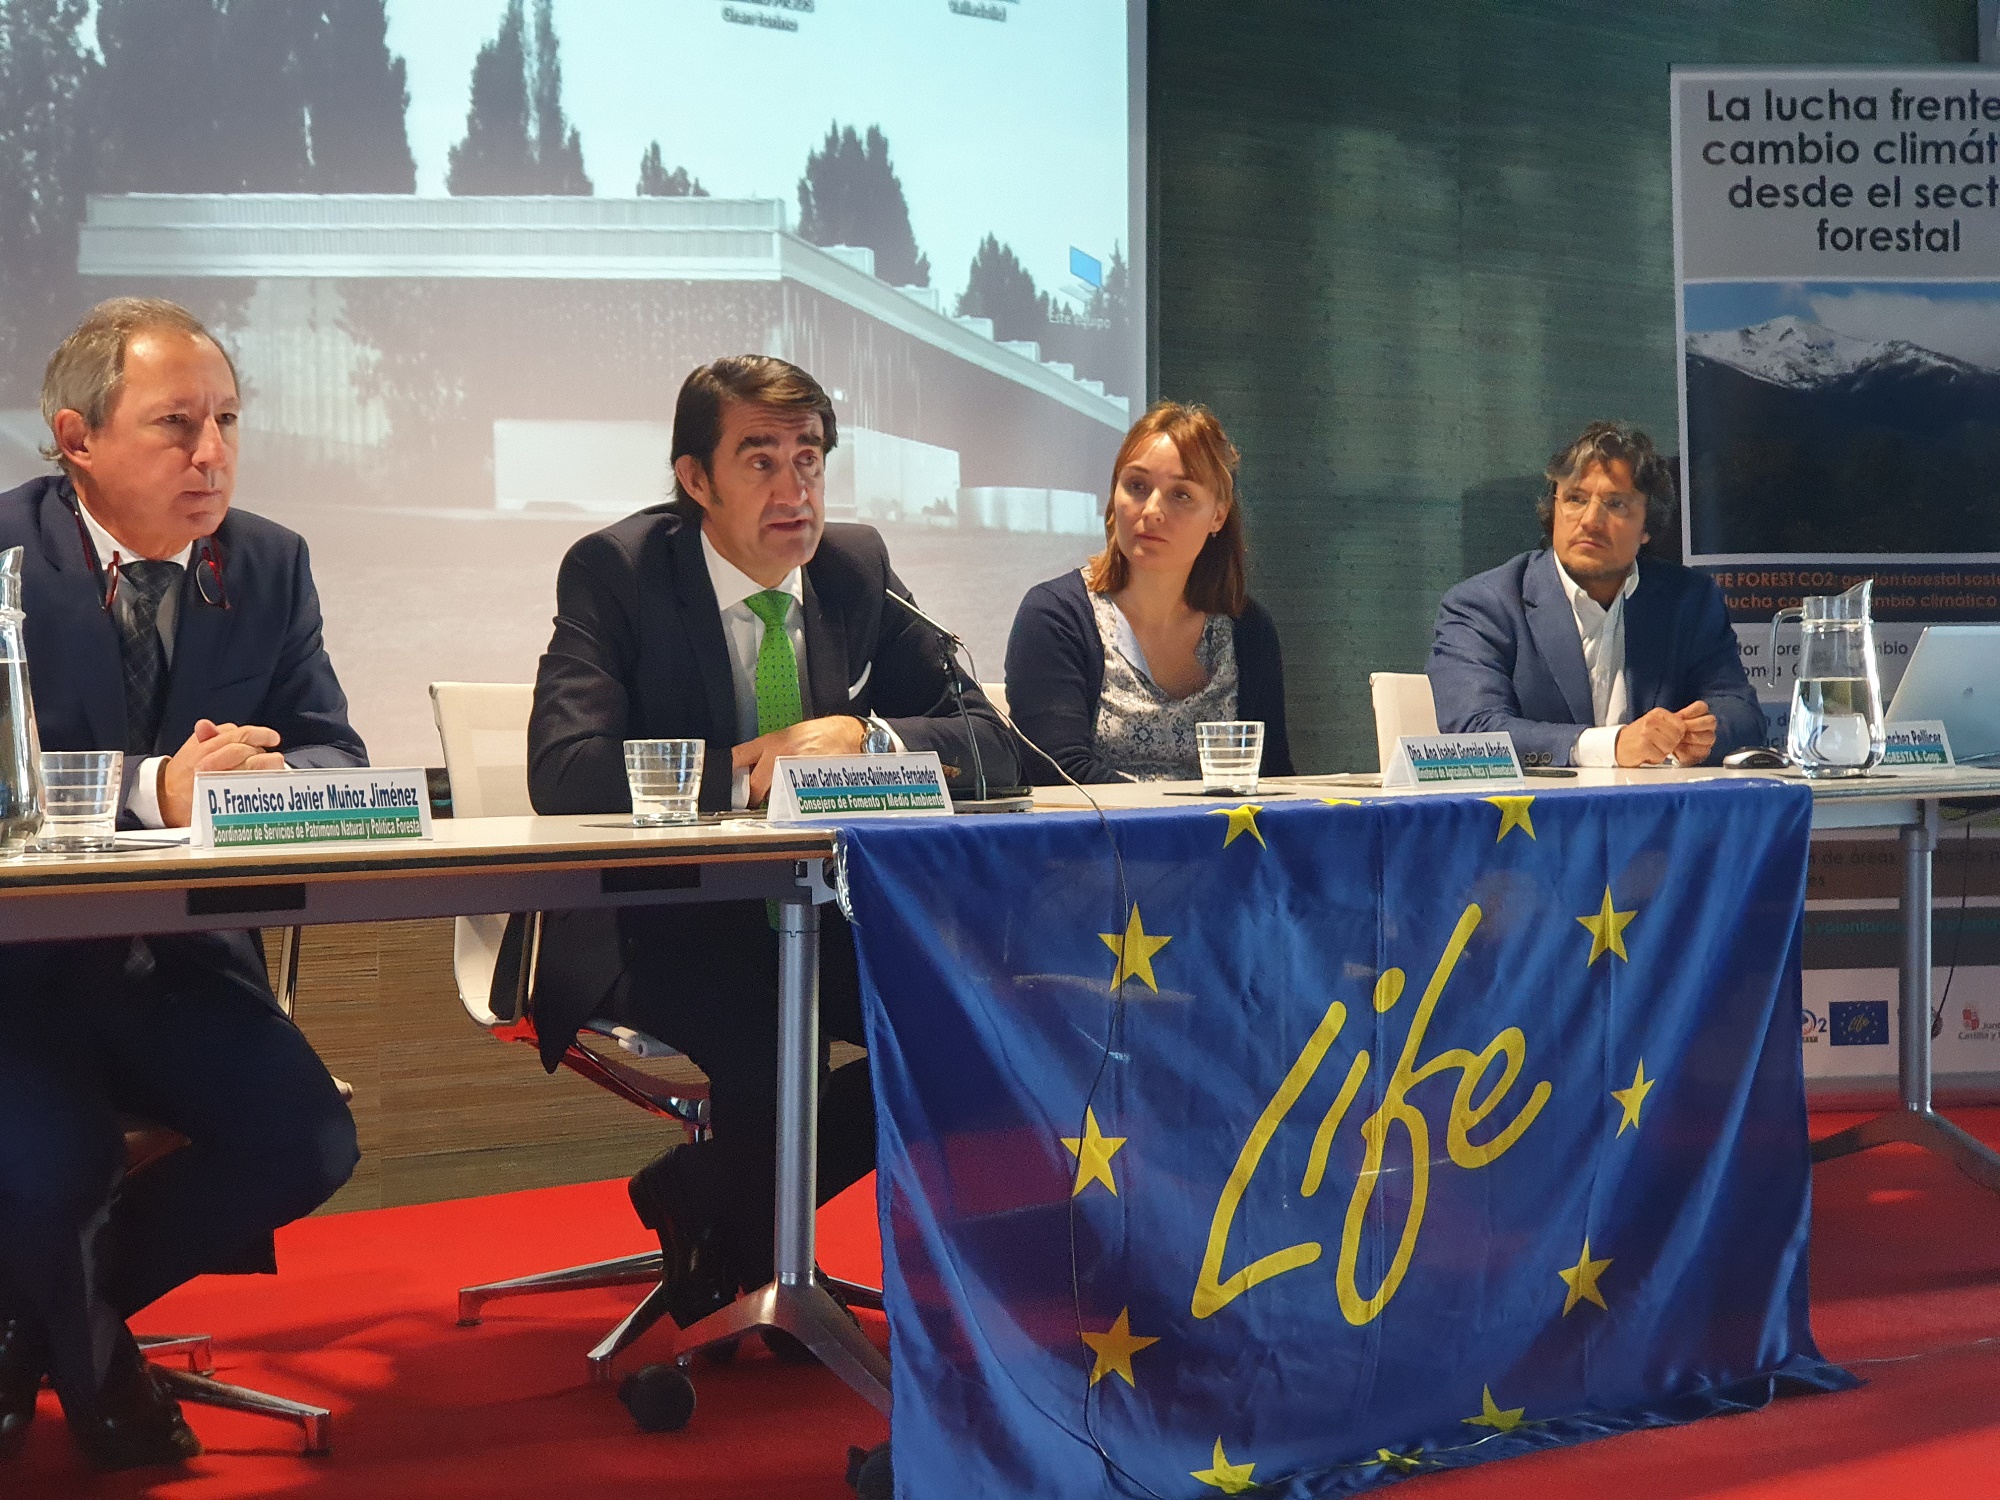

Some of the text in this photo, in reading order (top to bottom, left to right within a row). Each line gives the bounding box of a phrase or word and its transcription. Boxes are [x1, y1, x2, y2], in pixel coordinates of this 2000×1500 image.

[1707, 88, 2000, 122] La lucha frente
[1703, 127, 1999, 165] cambio climát
[1728, 174, 1999, 208] desde el sect
[1817, 218, 1961, 252] forestal
[1737, 571, 1795, 588] FOREST
[1902, 571, 1960, 587] forestal
[1965, 572, 2000, 587] soste
[1724, 593, 1773, 609] lucha
[1920, 591, 1997, 608] climático
[789, 769, 801, 789] D.
[800, 768, 819, 788] Juan
[818, 767, 843, 788] Carlos
[901, 765, 938, 785] Fernández
[208, 781, 418, 814] D. Francisco Javier Muñoz Jiménez
[798, 791, 945, 813] Consejero de Fomento y Medio Ambiente
[213, 825, 252, 843] Coordinador
[254, 824, 263, 841] de
[263, 821, 295, 841] Servicios
[296, 821, 305, 839] de
[304, 819, 341, 839] Patrimonio
[340, 818, 366, 836] Natural
[370, 817, 396, 835] Política
[1191, 903, 1553, 1326] Life
